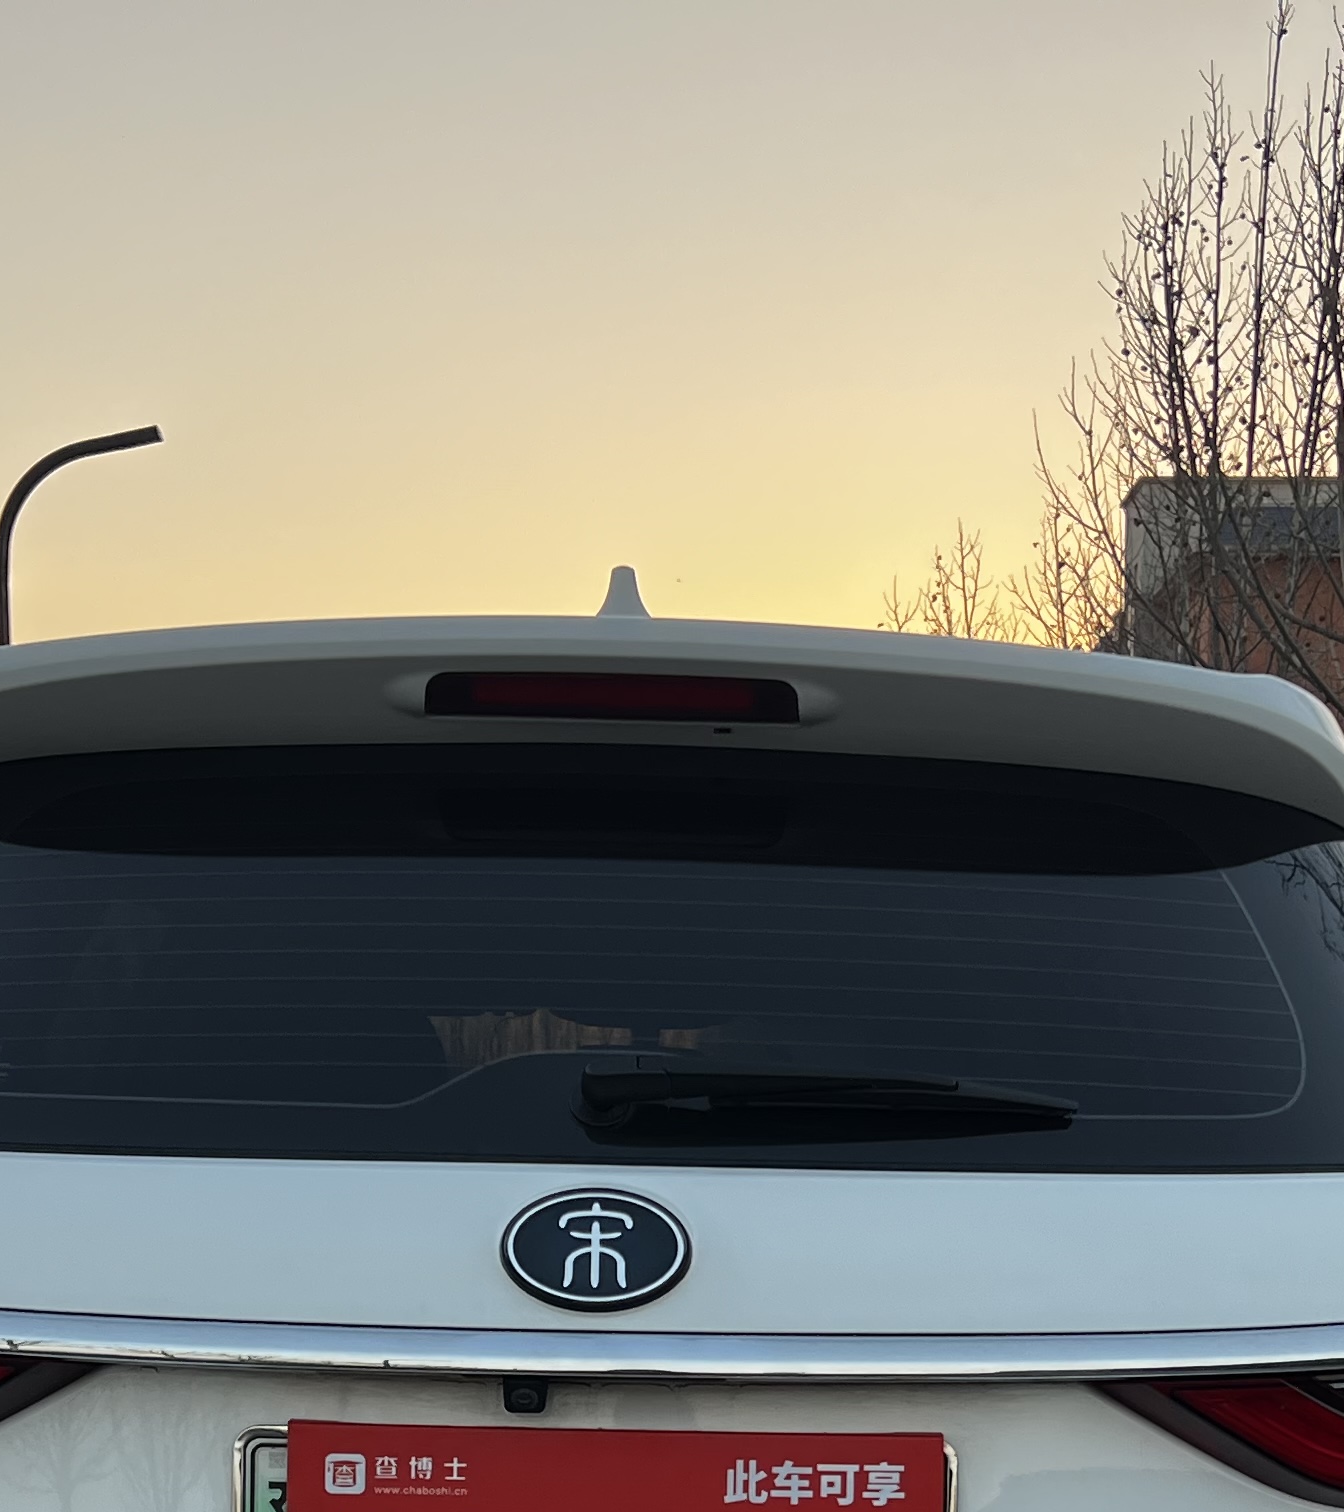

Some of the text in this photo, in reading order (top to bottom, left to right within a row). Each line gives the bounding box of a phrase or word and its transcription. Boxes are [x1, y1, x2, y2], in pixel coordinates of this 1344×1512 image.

[374, 1456, 468, 1481] 查博士
[374, 1485, 468, 1496] www.chaboshi.cn
[724, 1459, 906, 1506] 此车可享
